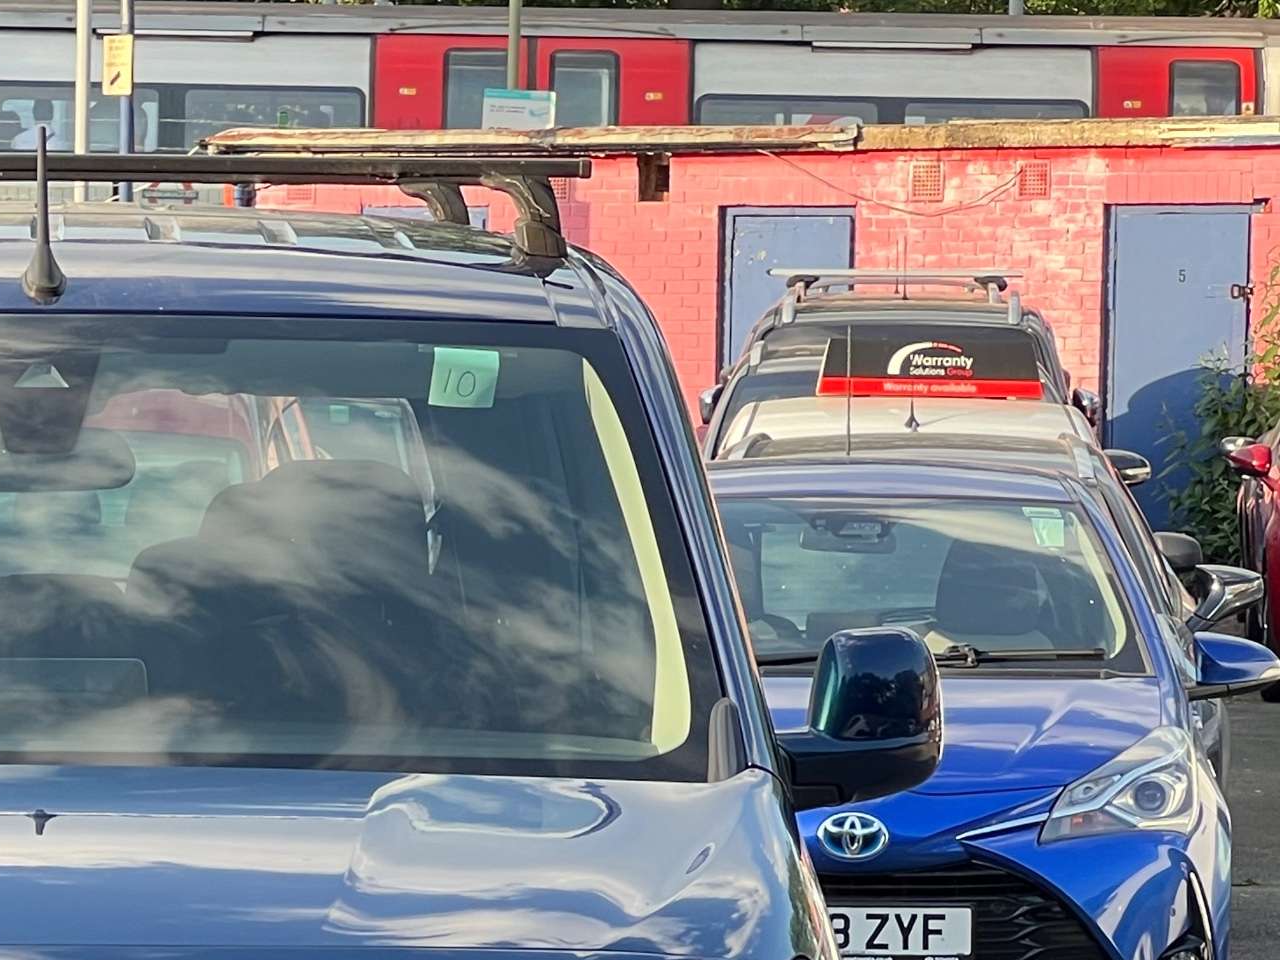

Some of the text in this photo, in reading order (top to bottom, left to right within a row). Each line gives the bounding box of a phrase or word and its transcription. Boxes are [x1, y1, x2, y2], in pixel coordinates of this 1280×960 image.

[1178, 268, 1186, 283] 5
[909, 354, 973, 369] Warranty
[909, 367, 945, 376] Solutions
[443, 368, 476, 398] 10
[865, 913, 946, 950] ZYF
